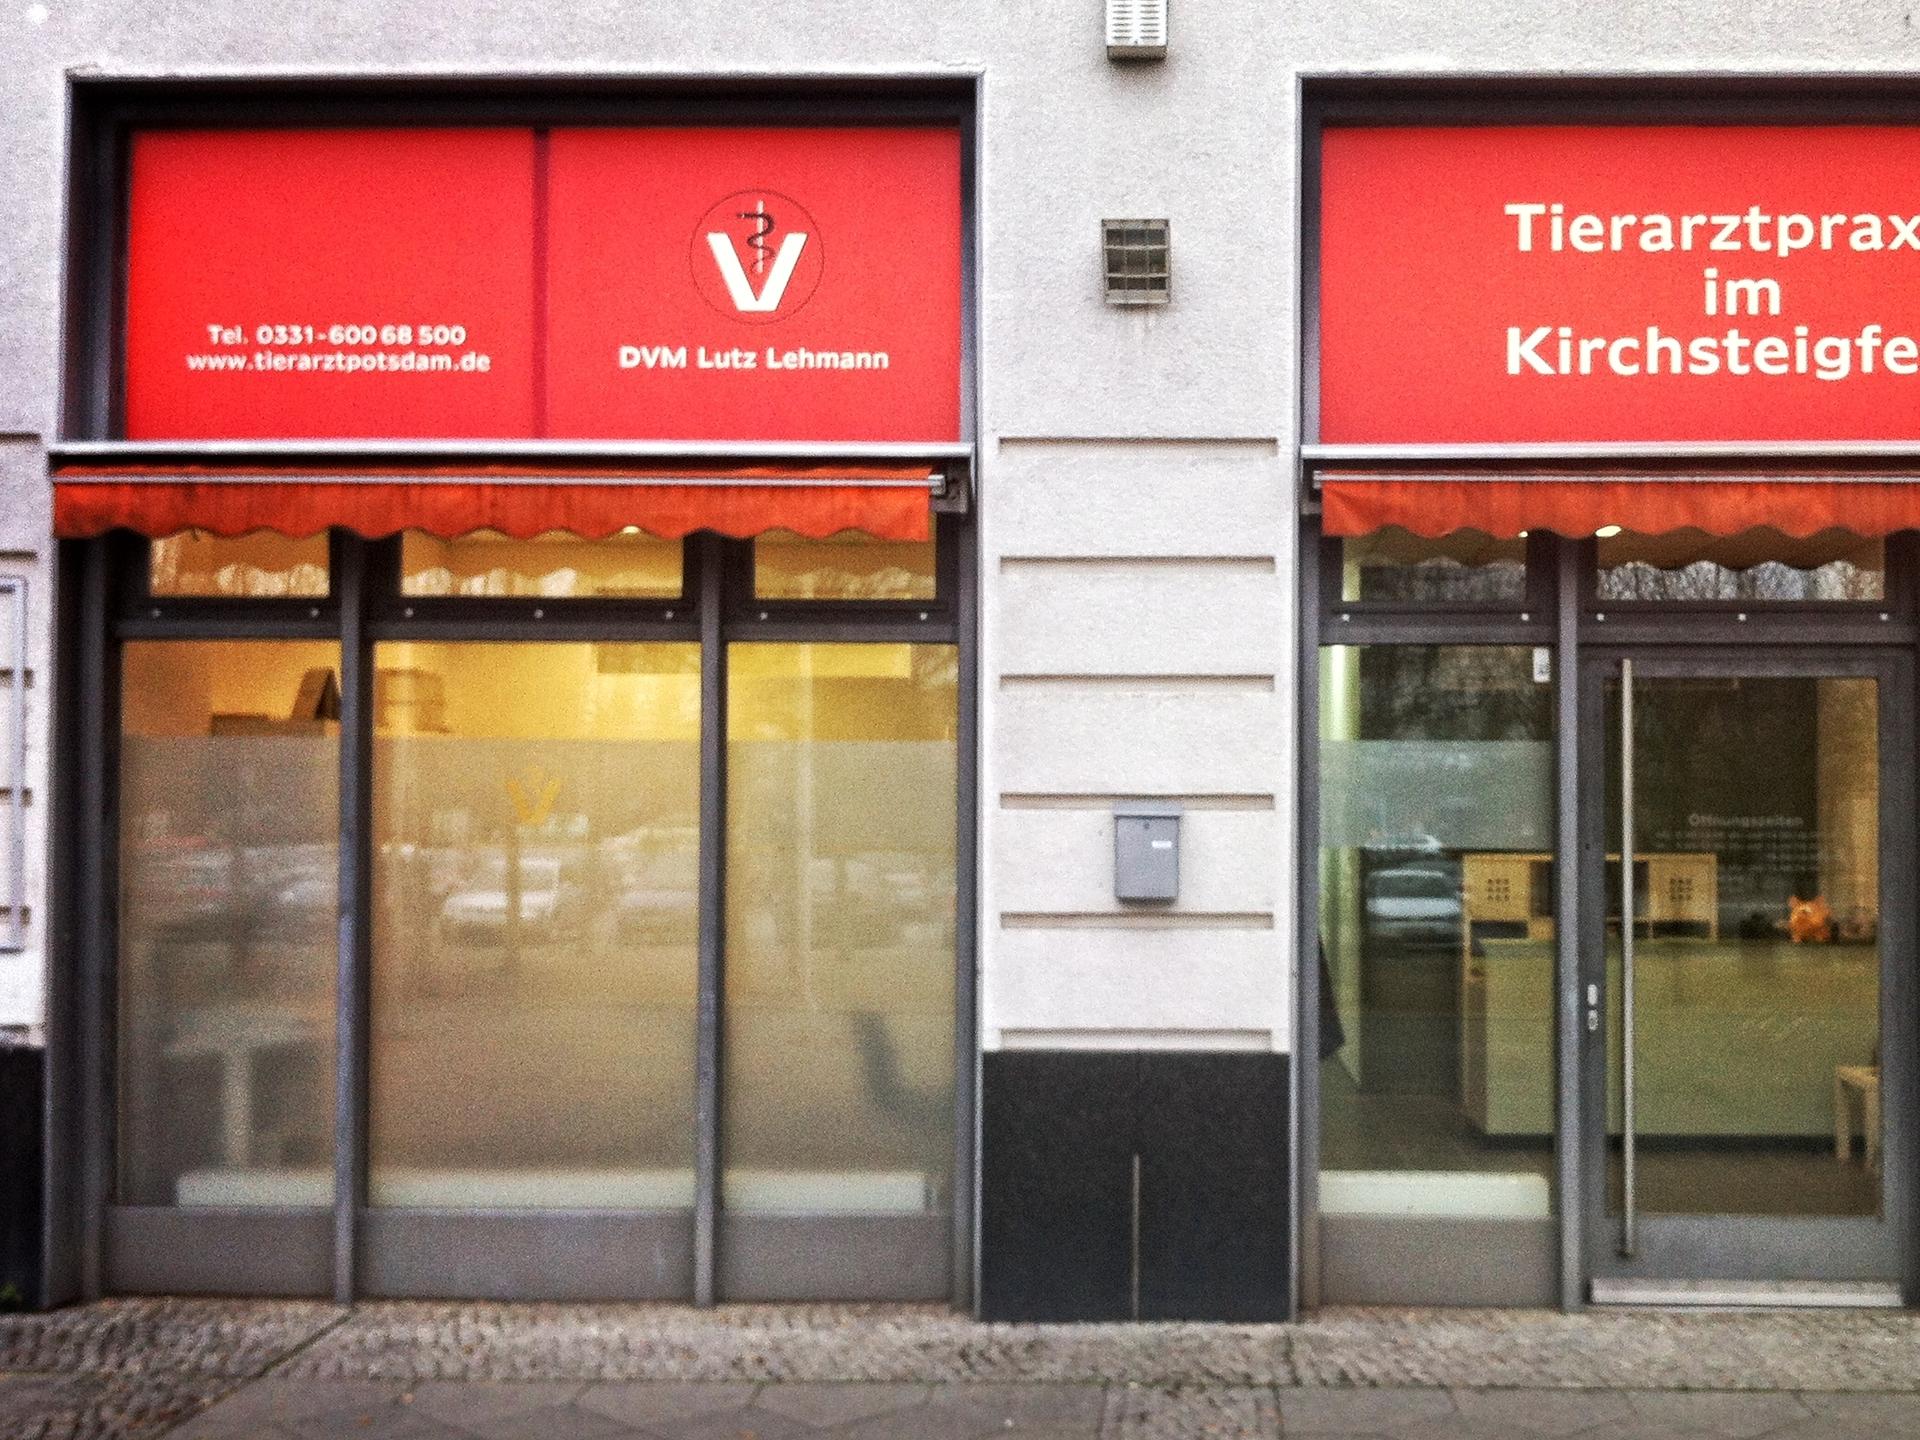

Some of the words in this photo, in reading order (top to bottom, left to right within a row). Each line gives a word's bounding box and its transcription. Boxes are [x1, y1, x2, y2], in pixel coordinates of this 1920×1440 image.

[1504, 203, 1920, 257] Tierarztprax
[1704, 267, 1782, 316] im
[208, 324, 248, 345] Tel.
[256, 324, 377, 345] 0331-600
[381, 324, 413, 345] 68
[418, 324, 467, 345] 500
[186, 351, 491, 372] www.tierarztpotsdam.de
[619, 346, 687, 369] DVM
[697, 346, 757, 369] Lutz
[766, 346, 889, 369] Lehmann
[1506, 325, 1920, 381] Kirchsteigfe
